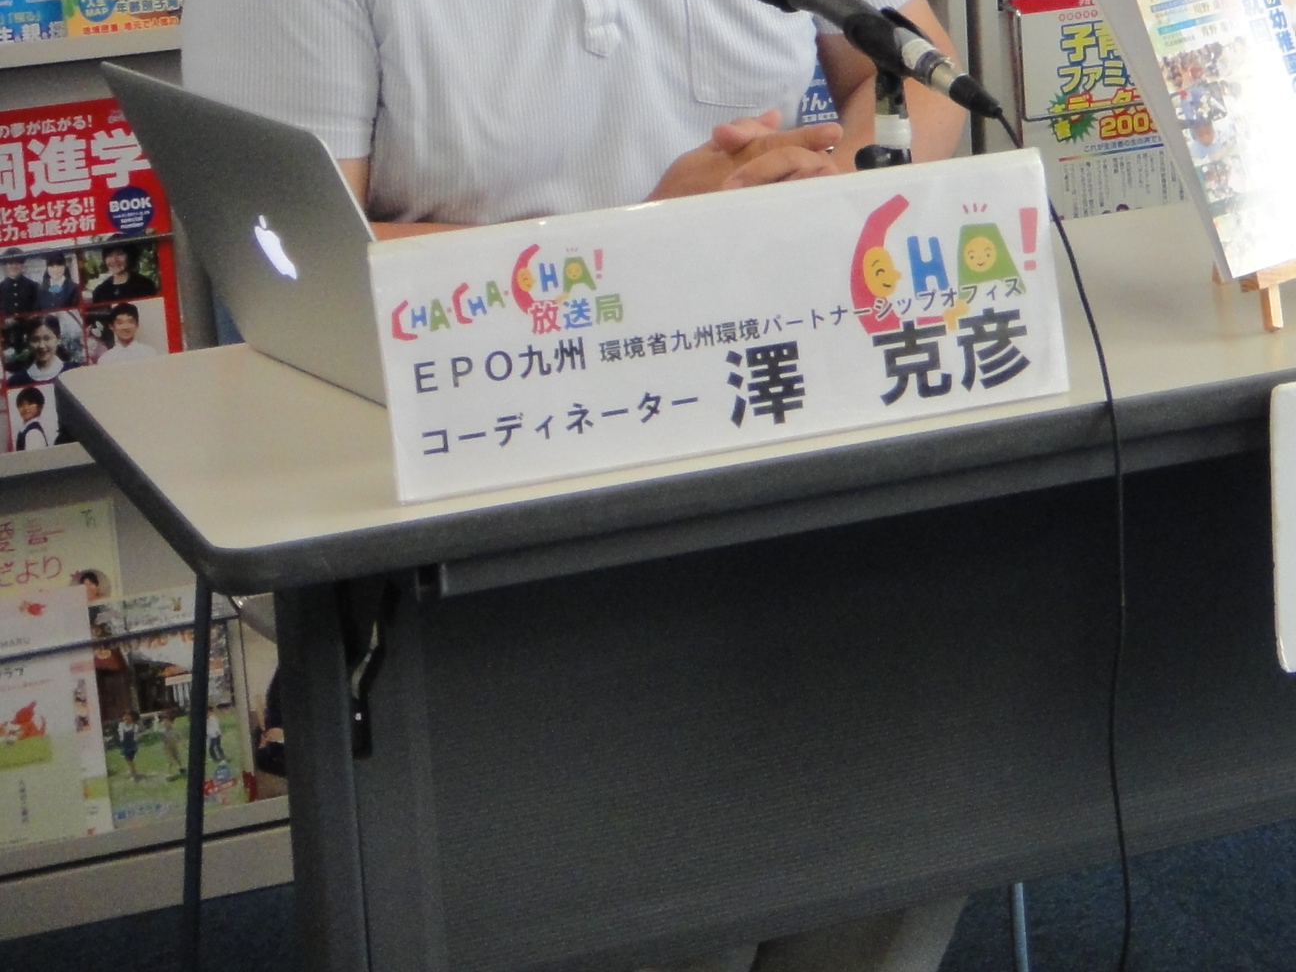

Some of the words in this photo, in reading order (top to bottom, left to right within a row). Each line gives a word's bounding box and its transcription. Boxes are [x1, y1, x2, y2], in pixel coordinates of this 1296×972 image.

[109, 197, 152, 212] BOOK
[529, 293, 624, 335] 放送局
[413, 336, 587, 394] EPO九州
[421, 392, 699, 456] コーディネーター
[724, 340, 806, 429] 澤
[871, 308, 1031, 406] 克彦
